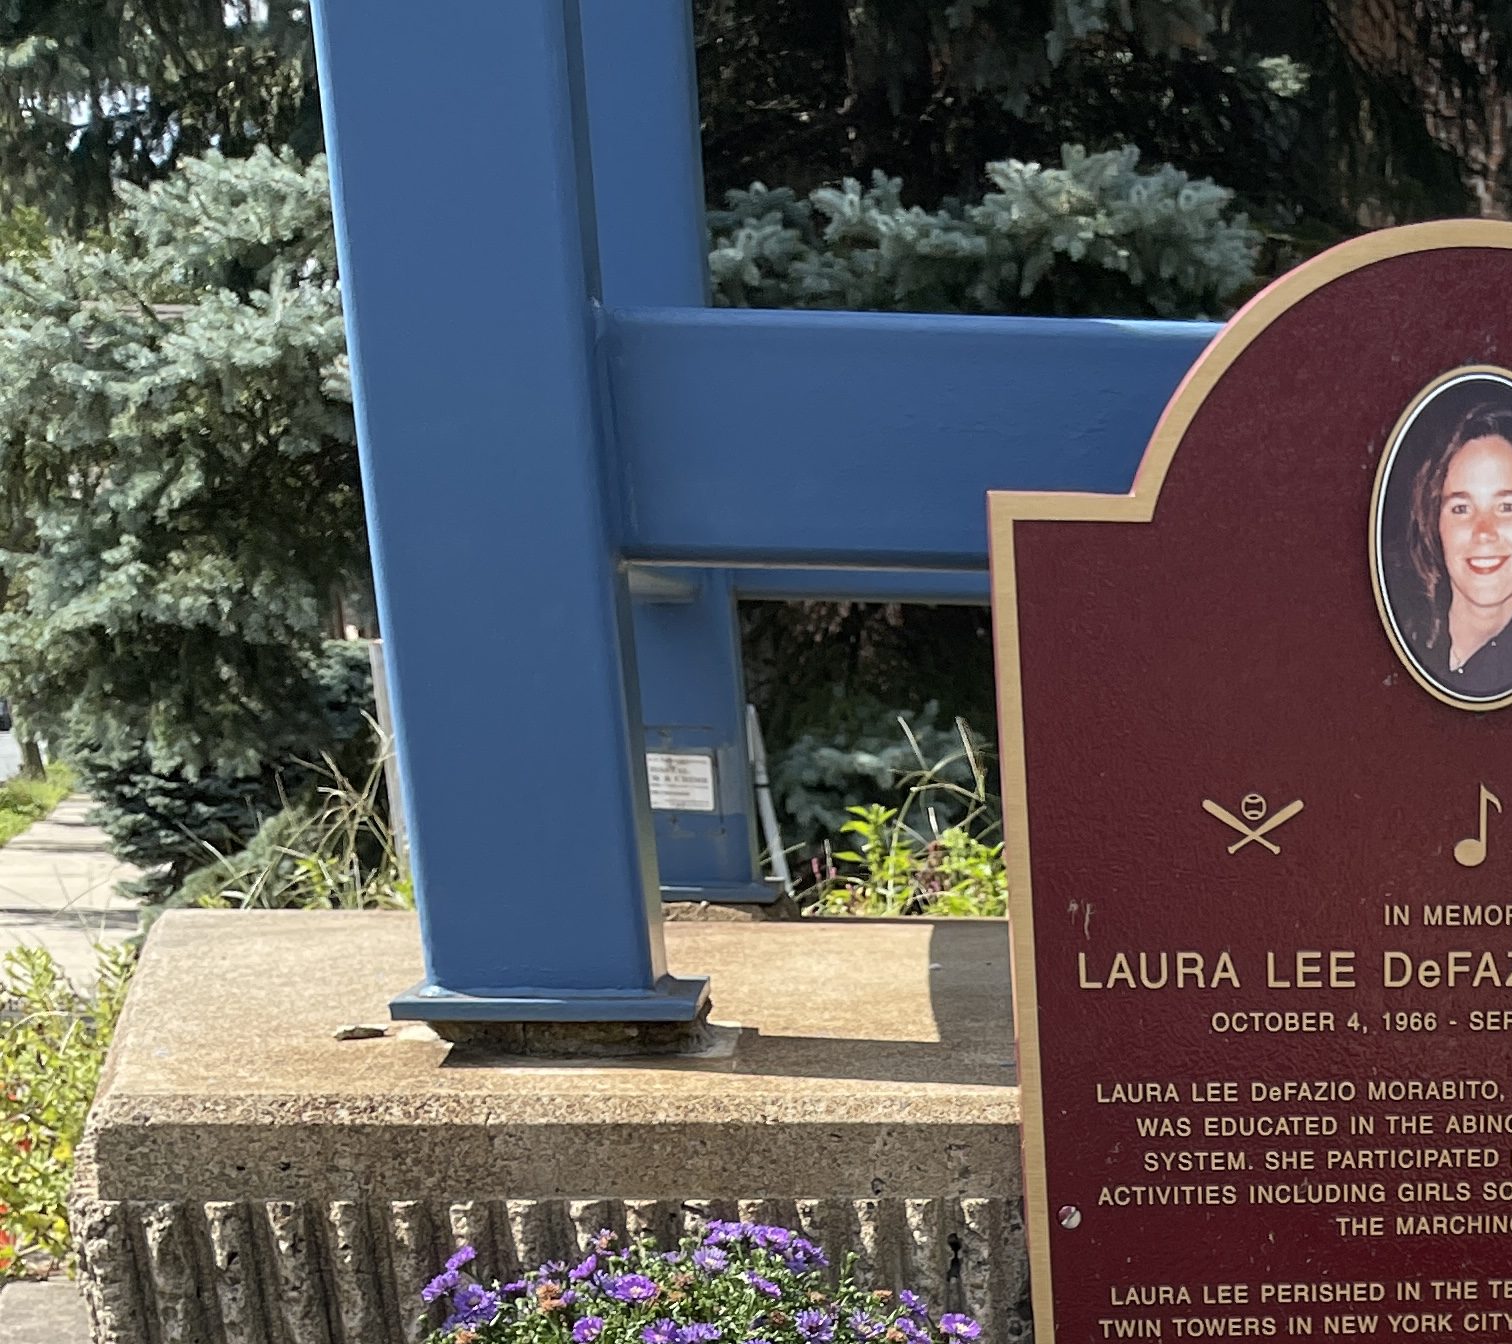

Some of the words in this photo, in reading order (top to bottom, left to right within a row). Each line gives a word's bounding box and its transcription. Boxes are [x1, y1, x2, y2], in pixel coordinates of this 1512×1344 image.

[1384, 905, 1410, 925] IN
[1078, 951, 1241, 989] LAURA
[1267, 951, 1356, 988] LEE
[1211, 1011, 1335, 1032] OCTOBER
[1346, 1012, 1368, 1034] 4,
[1382, 1012, 1438, 1031] 1966
[1096, 1083, 1180, 1103] LAURA
[1191, 1082, 1239, 1102] LEE
[1251, 1081, 1356, 1102] DeFAZIO
[1368, 1080, 1505, 1102] MORABITO,
[1136, 1117, 1192, 1137] WAS
[1204, 1116, 1338, 1137] EDUCATED
[1350, 1115, 1374, 1135] IN
[1384, 1115, 1434, 1135] THE
[1144, 1151, 1254, 1171] SYSTEM.
[1265, 1151, 1315, 1170] SHE
[1327, 1148, 1500, 1169] PARTICIPATED
[1098, 1185, 1237, 1206] ACTIVITIES
[1249, 1183, 1386, 1204] INCLUDING
[1397, 1182, 1472, 1202] GIRLS
[1335, 1216, 1385, 1236] THE
[1111, 1286, 1192, 1306] LAURA
[1203, 1285, 1249, 1304] LEE
[1260, 1282, 1386, 1303] PERISHED
[1397, 1282, 1421, 1301] IN
[1430, 1280, 1478, 1300] THE
[1098, 1319, 1162, 1339] TWIN
[1171, 1317, 1277, 1337] TOWERS
[1288, 1316, 1312, 1335] IN
[1324, 1315, 1379, 1334] NEW
[1387, 1313, 1453, 1333] YORK
